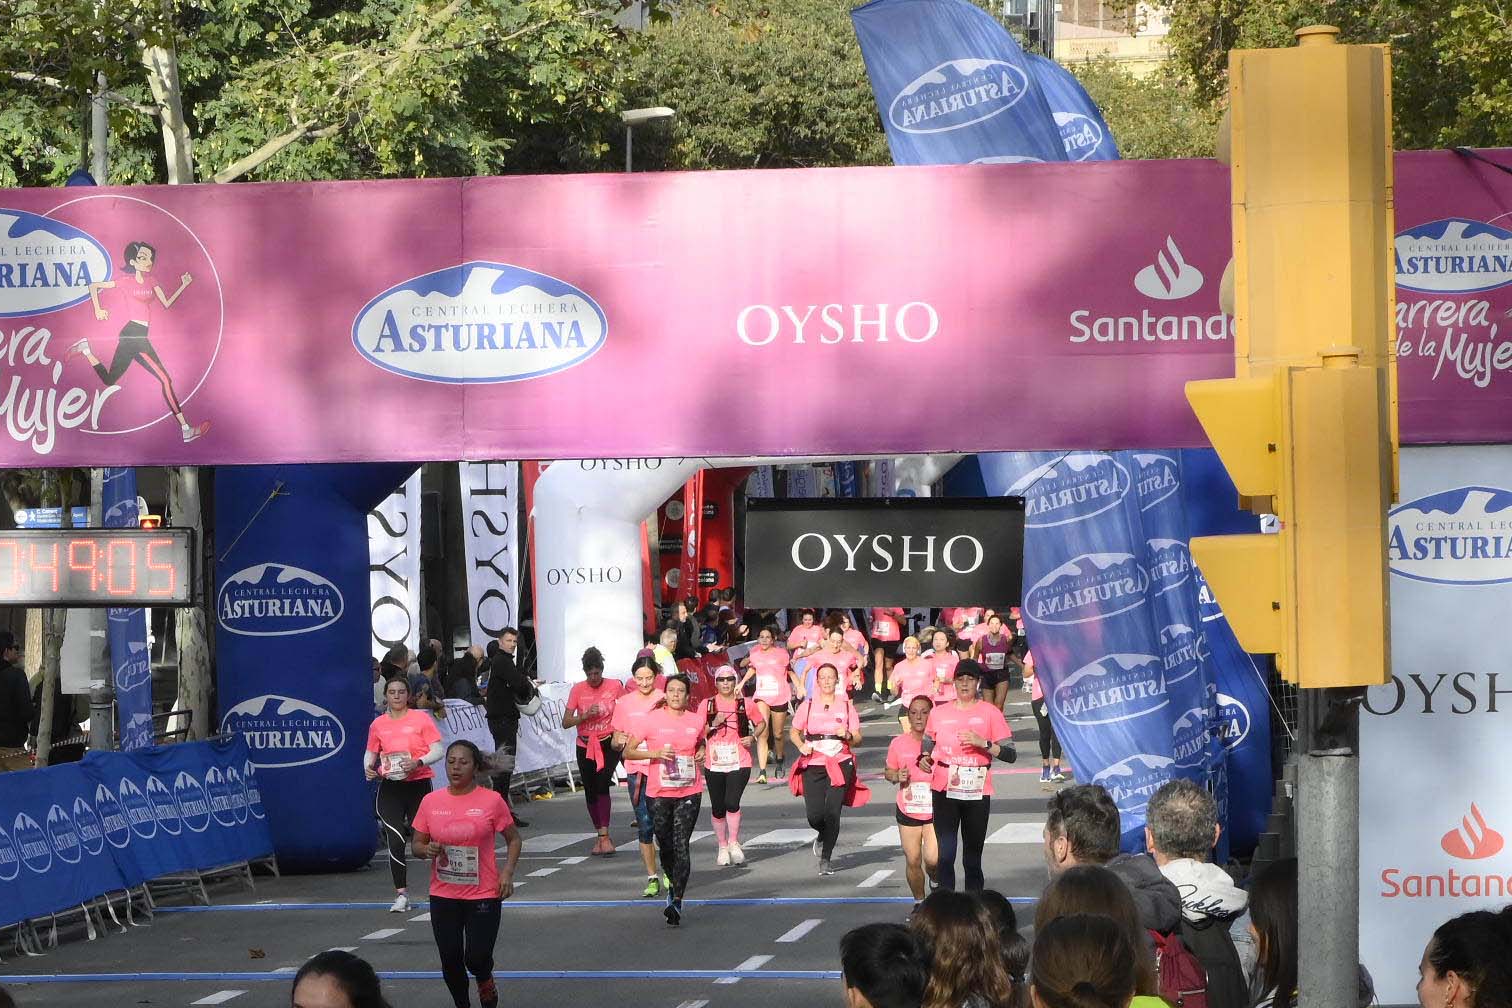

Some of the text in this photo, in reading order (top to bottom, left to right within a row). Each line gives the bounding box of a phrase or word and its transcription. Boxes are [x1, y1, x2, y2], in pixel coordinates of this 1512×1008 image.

[15, 245, 87, 256] LECHERA
[1409, 242, 1511, 252] CENTRAL LECHER
[411, 303, 579, 317] CENTRAL LECHERA
[737, 301, 938, 346] OYSHO
[1395, 299, 1489, 329] arrera
[372, 308, 585, 353] ASTURIANA
[1070, 308, 1236, 343] Santand
[1418, 329, 1436, 357] la
[1432, 324, 1512, 388] Muje
[1416, 521, 1483, 531] CENTRAL
[791, 533, 984, 574] OYSHO
[547, 565, 623, 586] OYSHO
[234, 588, 330, 596] CENTRAL LECHERA
[222, 593, 334, 620] ASTURIANA
[1363, 672, 1512, 716] OYSH
